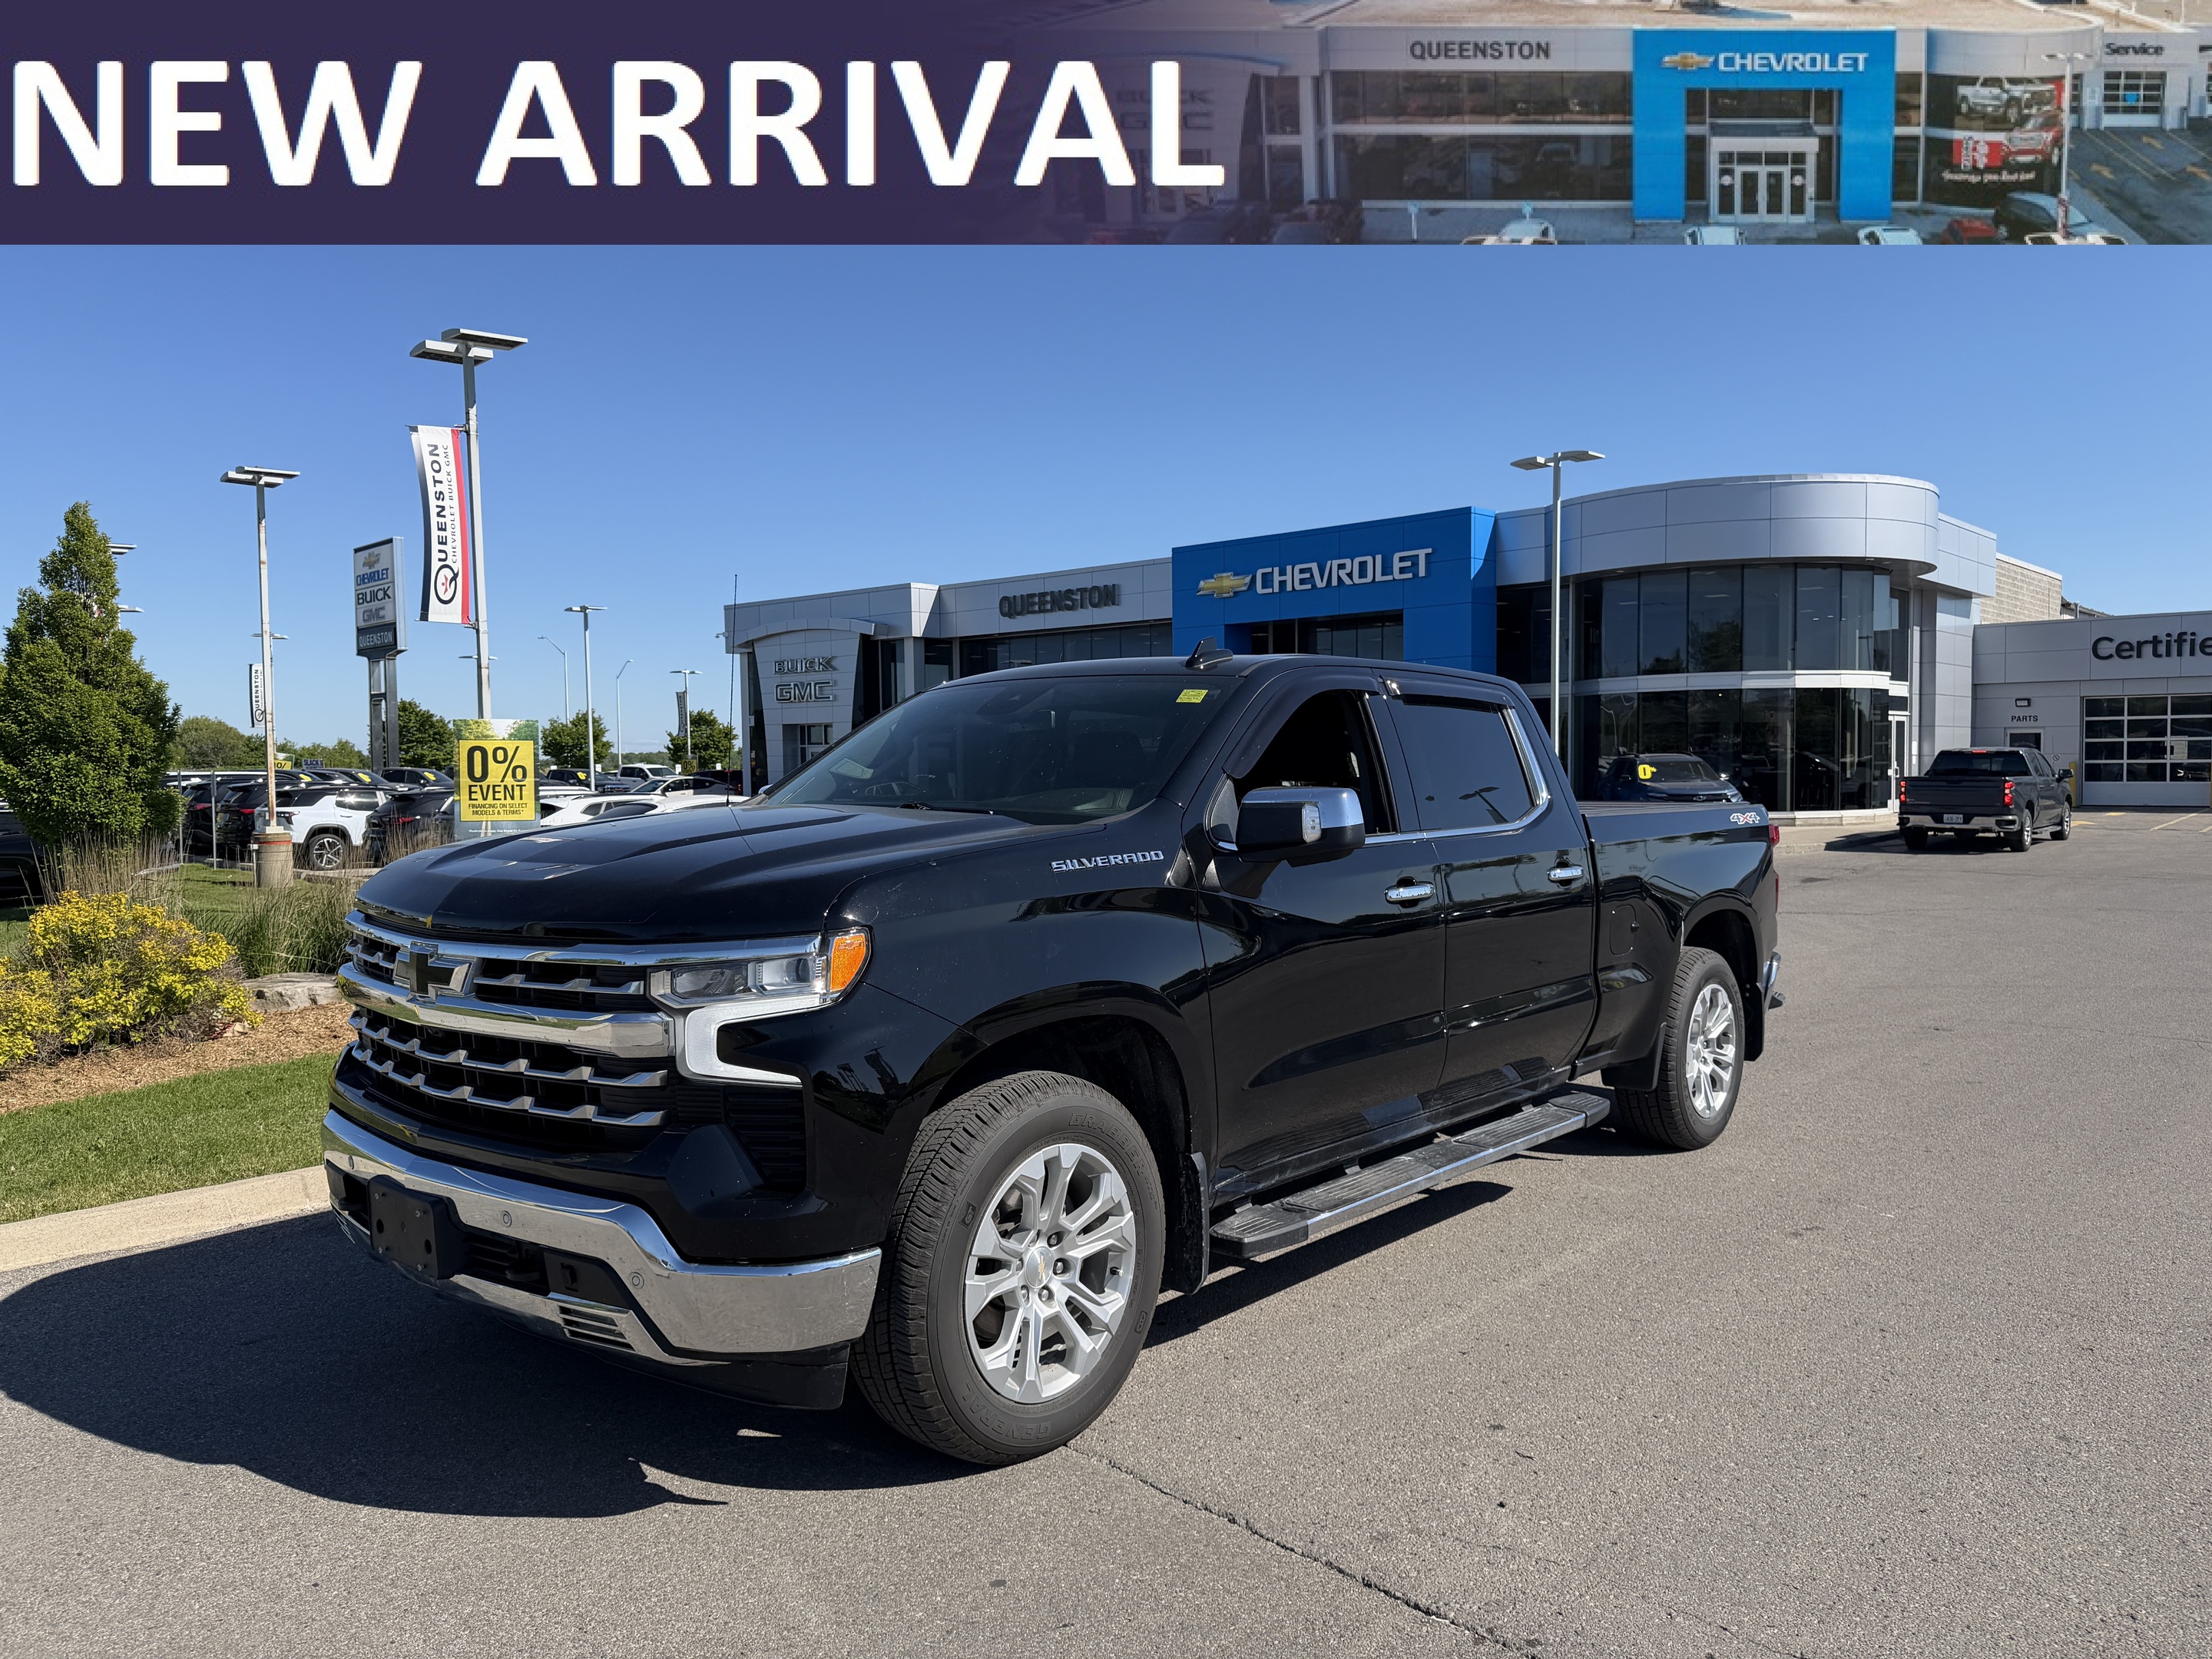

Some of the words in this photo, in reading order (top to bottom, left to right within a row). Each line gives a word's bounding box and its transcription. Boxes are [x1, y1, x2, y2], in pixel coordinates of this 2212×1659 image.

[442, 444, 451, 467] GMC
[427, 443, 460, 605] QUEENSTON
[449, 505, 458, 564] CHEVROLET
[356, 568, 389, 587] CHEVROLET
[1255, 548, 1432, 595] CHEVROLET
[356, 585, 392, 605] BUICK
[999, 584, 1120, 620] QUEENSTON
[362, 606, 386, 624] GMC
[359, 631, 393, 647] QUEENSTON
[773, 656, 835, 675] BUICK
[775, 680, 834, 703] GMC
[466, 745, 528, 783] 0%
[468, 784, 526, 801] EVENT
[1050, 849, 1164, 873] SILVERADO
[1068, 1113, 1147, 1177] GRABBER
[962, 1382, 1052, 1441] GENERAL
